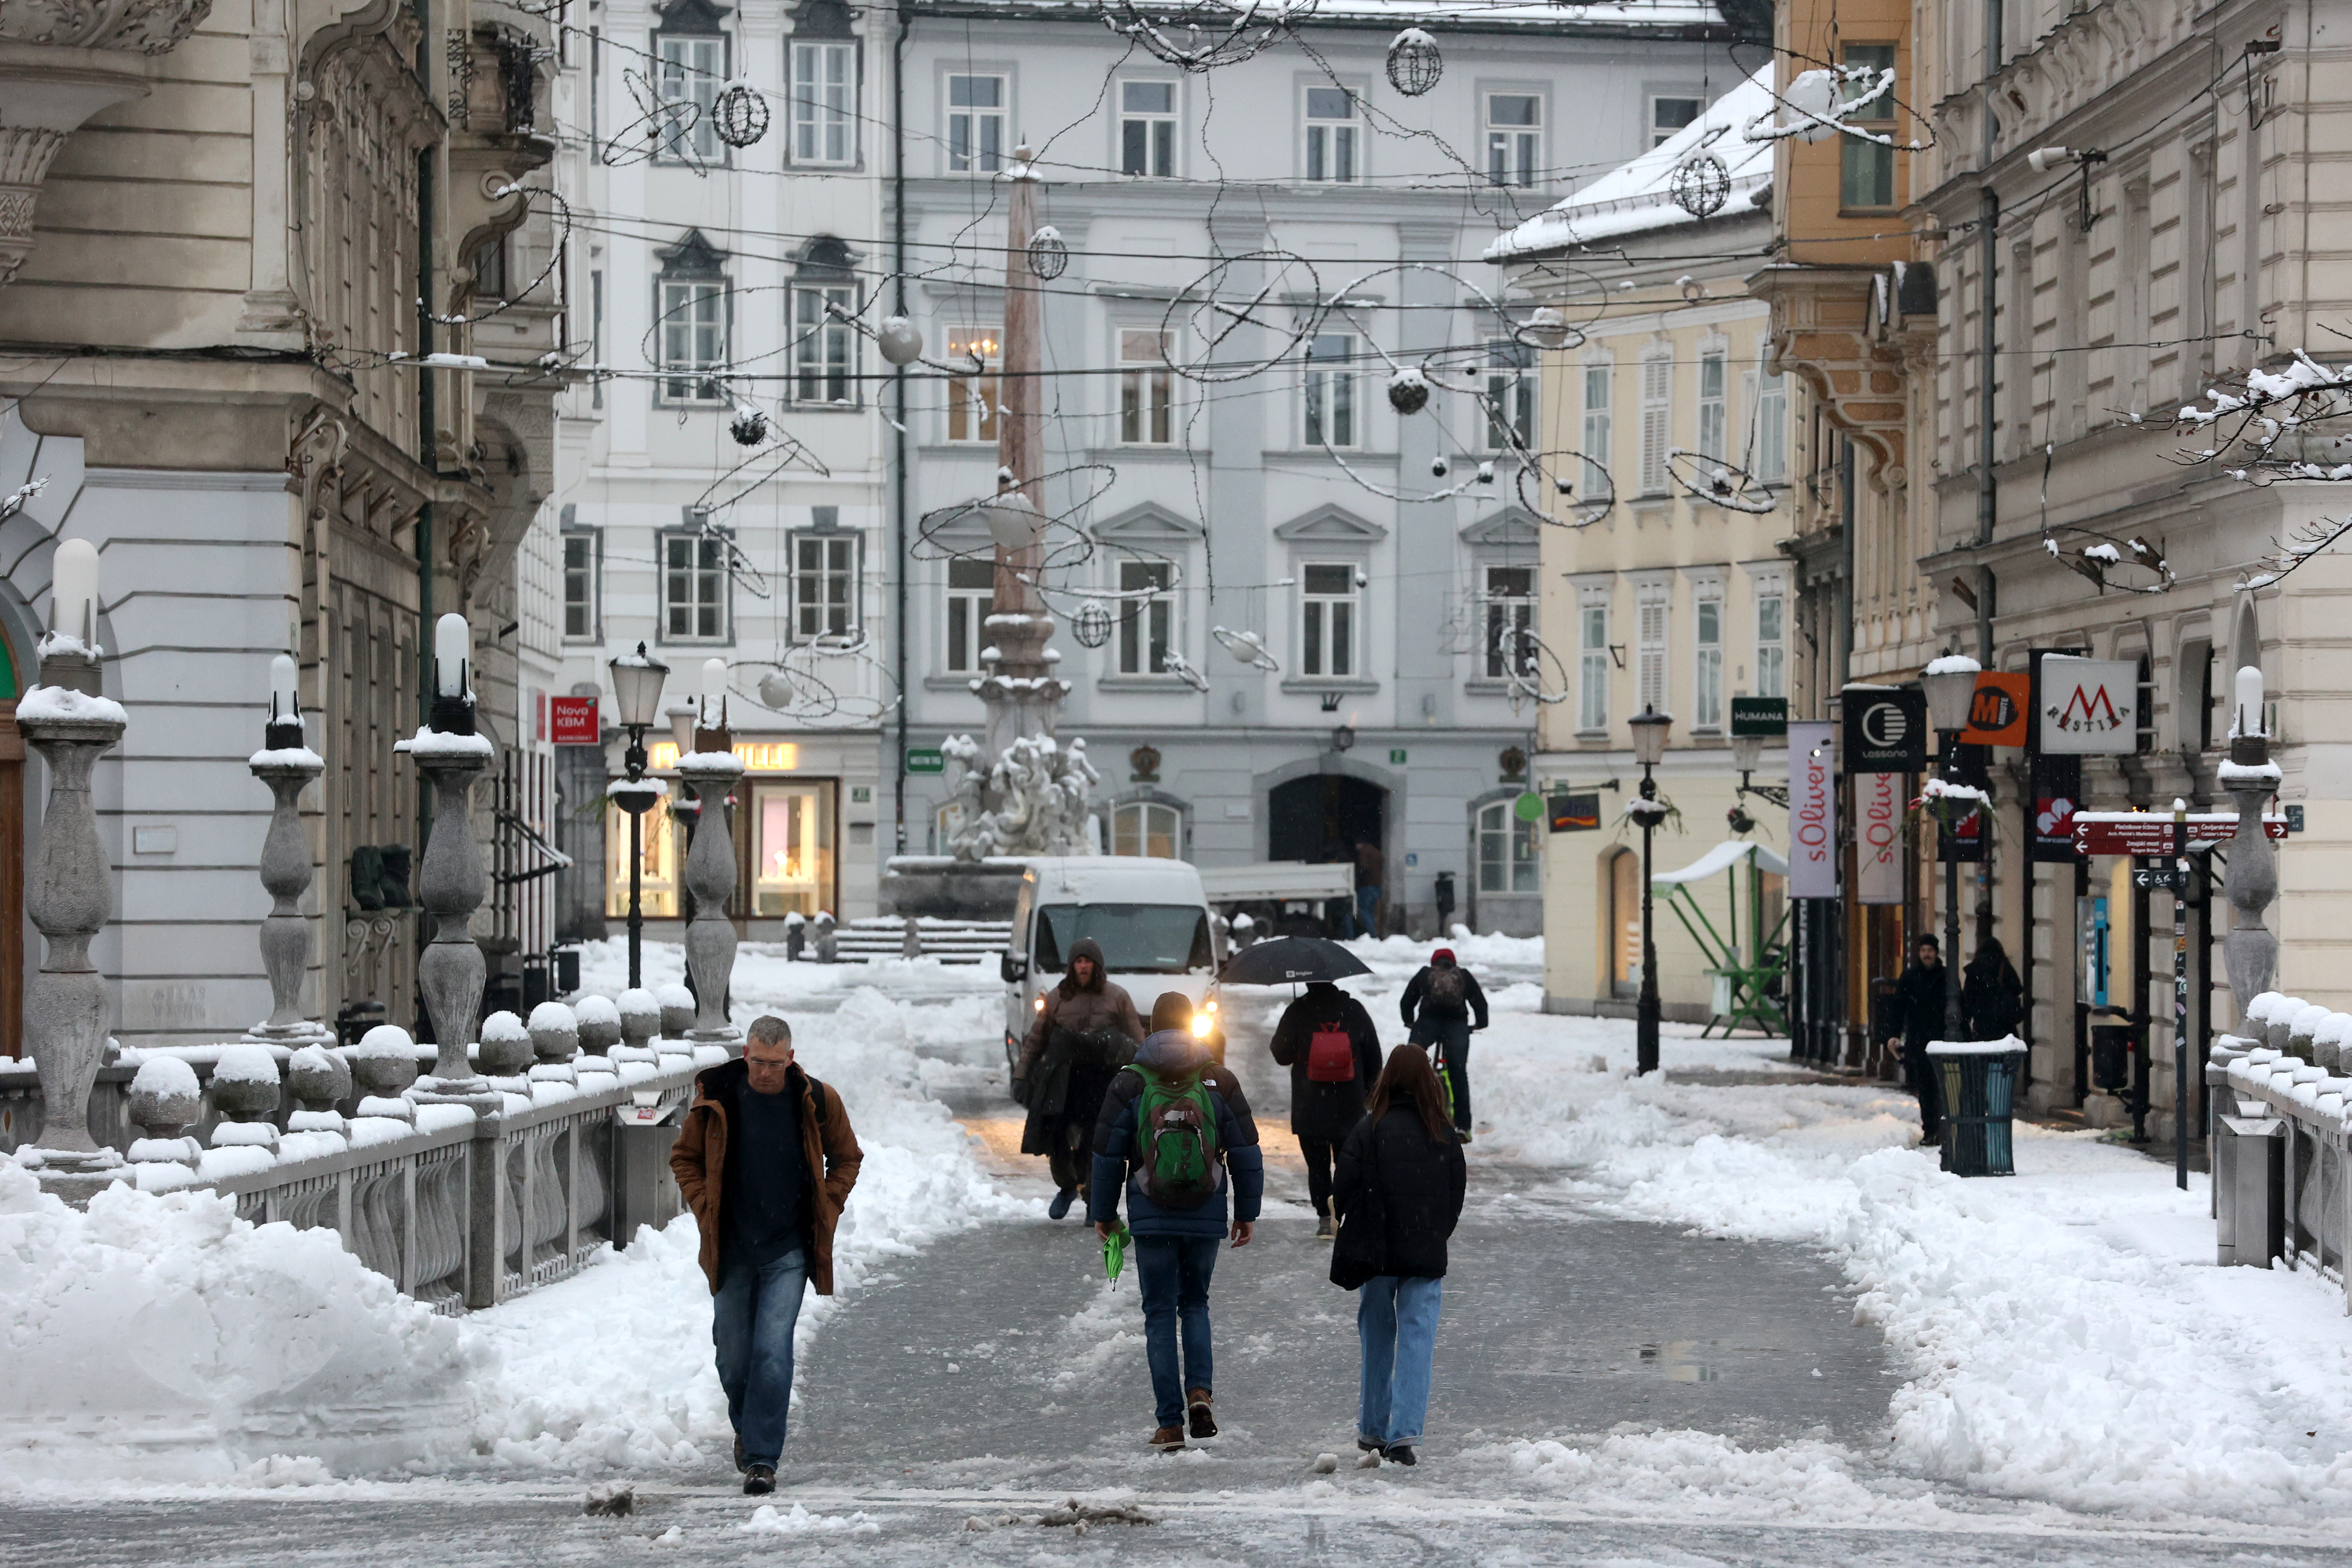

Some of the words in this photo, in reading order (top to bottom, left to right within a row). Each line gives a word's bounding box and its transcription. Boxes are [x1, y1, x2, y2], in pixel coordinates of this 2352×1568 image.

[557, 705, 589, 716] Nova
[557, 717, 585, 727] KBM
[1735, 712, 1784, 721] HUMANA
[1798, 759, 1827, 861] s.Oliver
[1866, 773, 1894, 863] s.Olive
